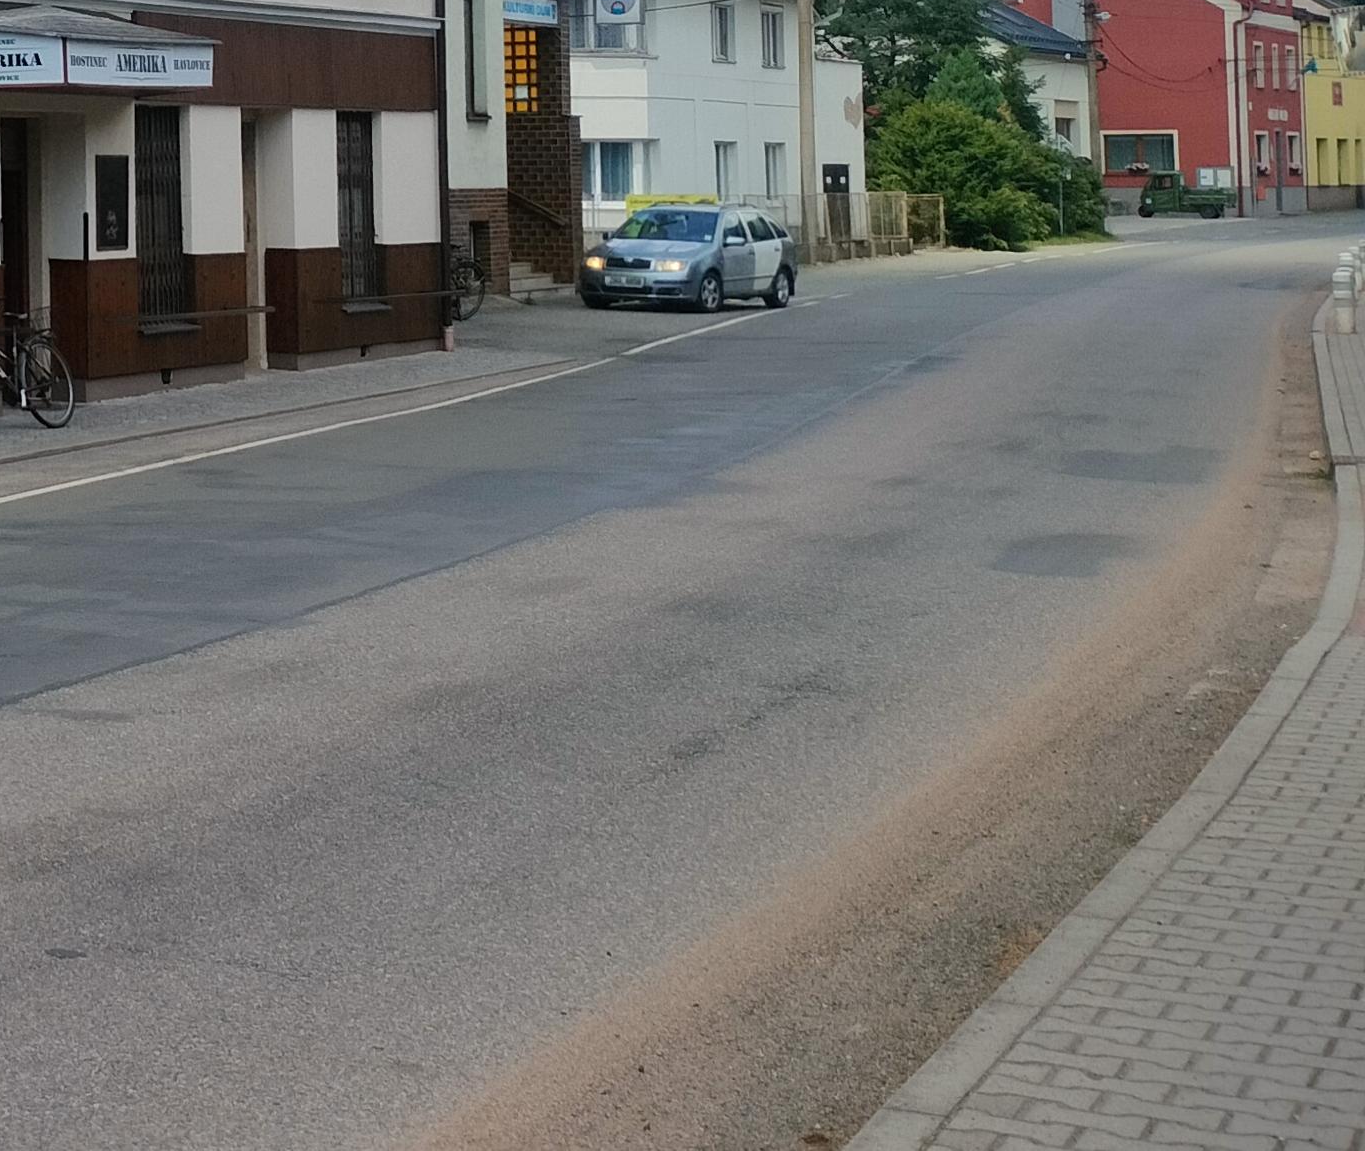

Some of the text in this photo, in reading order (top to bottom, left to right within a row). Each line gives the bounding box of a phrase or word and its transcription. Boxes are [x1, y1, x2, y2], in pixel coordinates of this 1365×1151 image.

[70, 53, 211, 73] HOSTINEC AMERIKA HAVLOVICE
